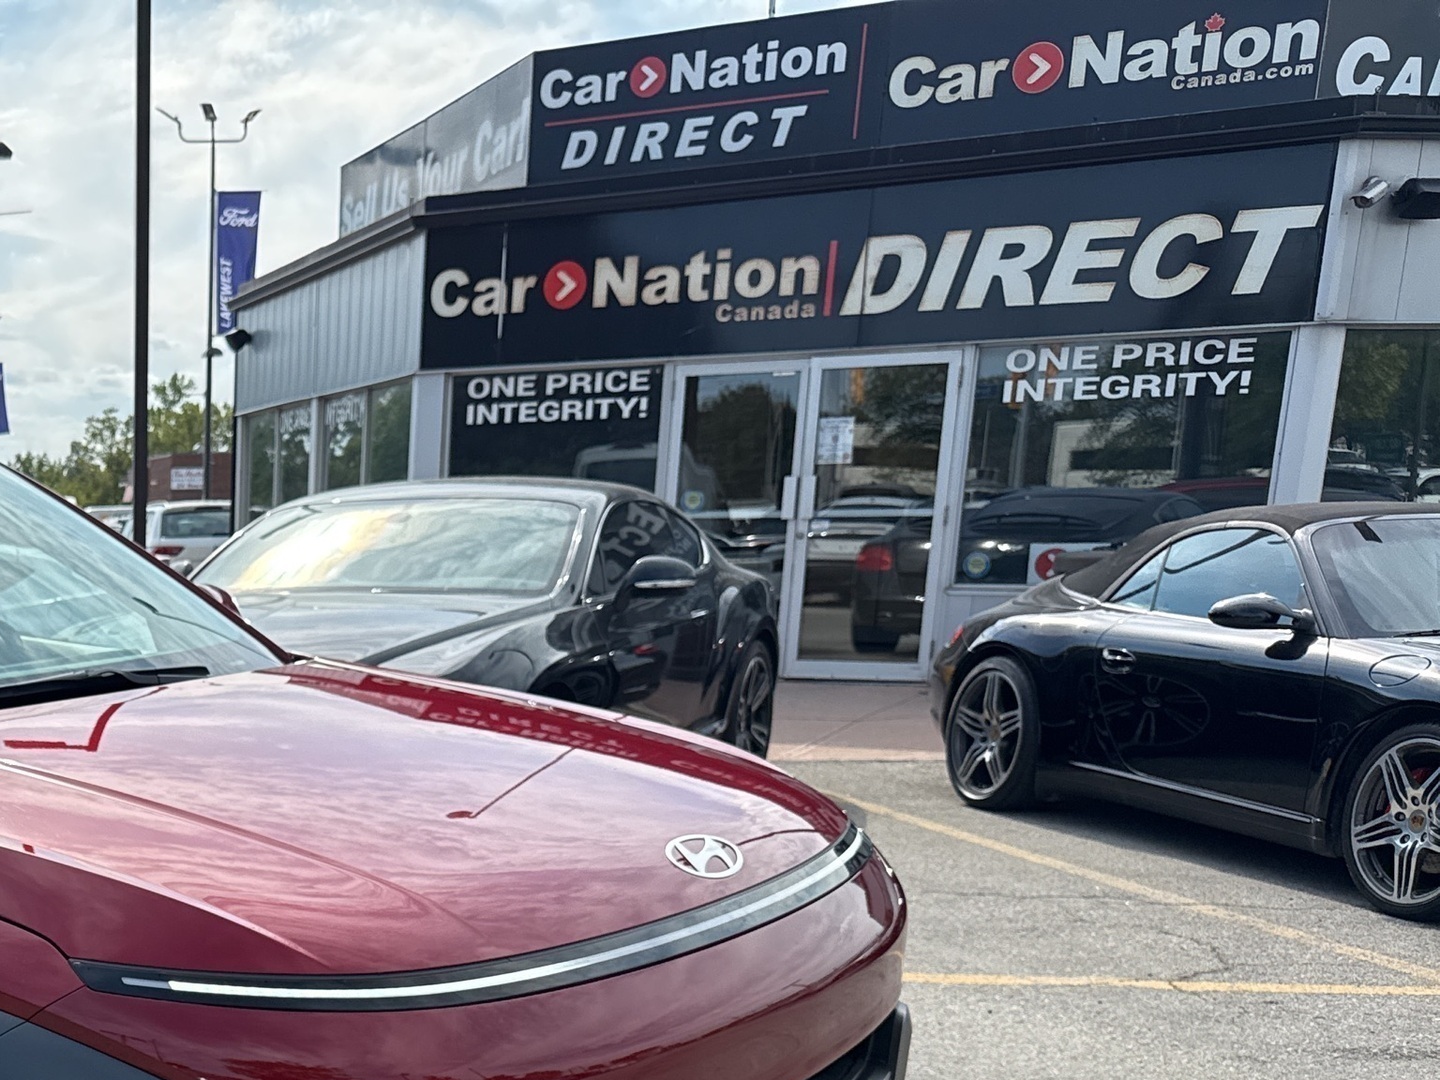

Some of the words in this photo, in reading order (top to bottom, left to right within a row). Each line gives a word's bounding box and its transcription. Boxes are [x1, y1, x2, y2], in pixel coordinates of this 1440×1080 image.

[539, 68, 626, 110] Car
[669, 39, 848, 94] Nation
[888, 55, 1011, 109] Car
[1067, 12, 1321, 89] Nation
[1170, 61, 1315, 91] Canada.com
[1336, 35, 1440, 97] CA
[560, 103, 809, 171] DIRECT
[220, 207, 258, 228] Ford
[838, 203, 1326, 317] DIRECT
[429, 267, 539, 319] Car
[591, 246, 822, 309] Nation
[714, 301, 817, 323] Canada
[1005, 346, 1101, 375] ONE
[1111, 337, 1259, 369] PRICE
[466, 373, 538, 400] ONE
[544, 368, 651, 396] PRICE
[1002, 370, 1252, 404] INTEGRITY!
[465, 396, 650, 426] INTEGRITY!
